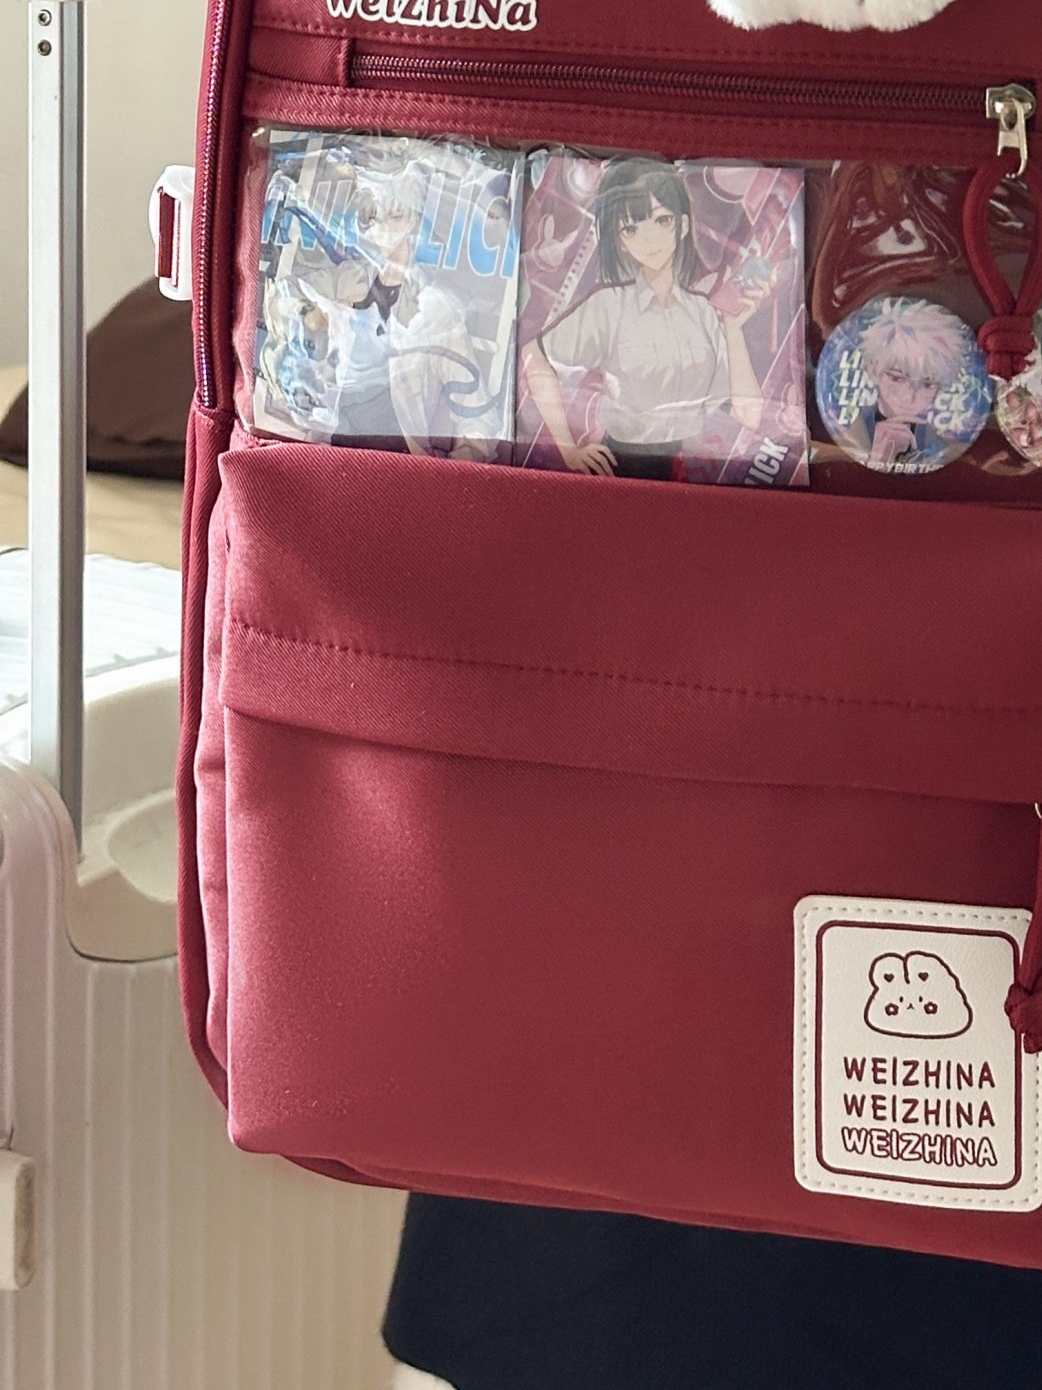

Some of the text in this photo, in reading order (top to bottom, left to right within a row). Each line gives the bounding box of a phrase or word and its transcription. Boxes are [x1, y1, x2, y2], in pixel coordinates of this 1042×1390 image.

[843, 1056, 996, 1090] WEIZHINA
[843, 1093, 996, 1128] WEIZHINA
[841, 1126, 998, 1167] WEIZHINA
